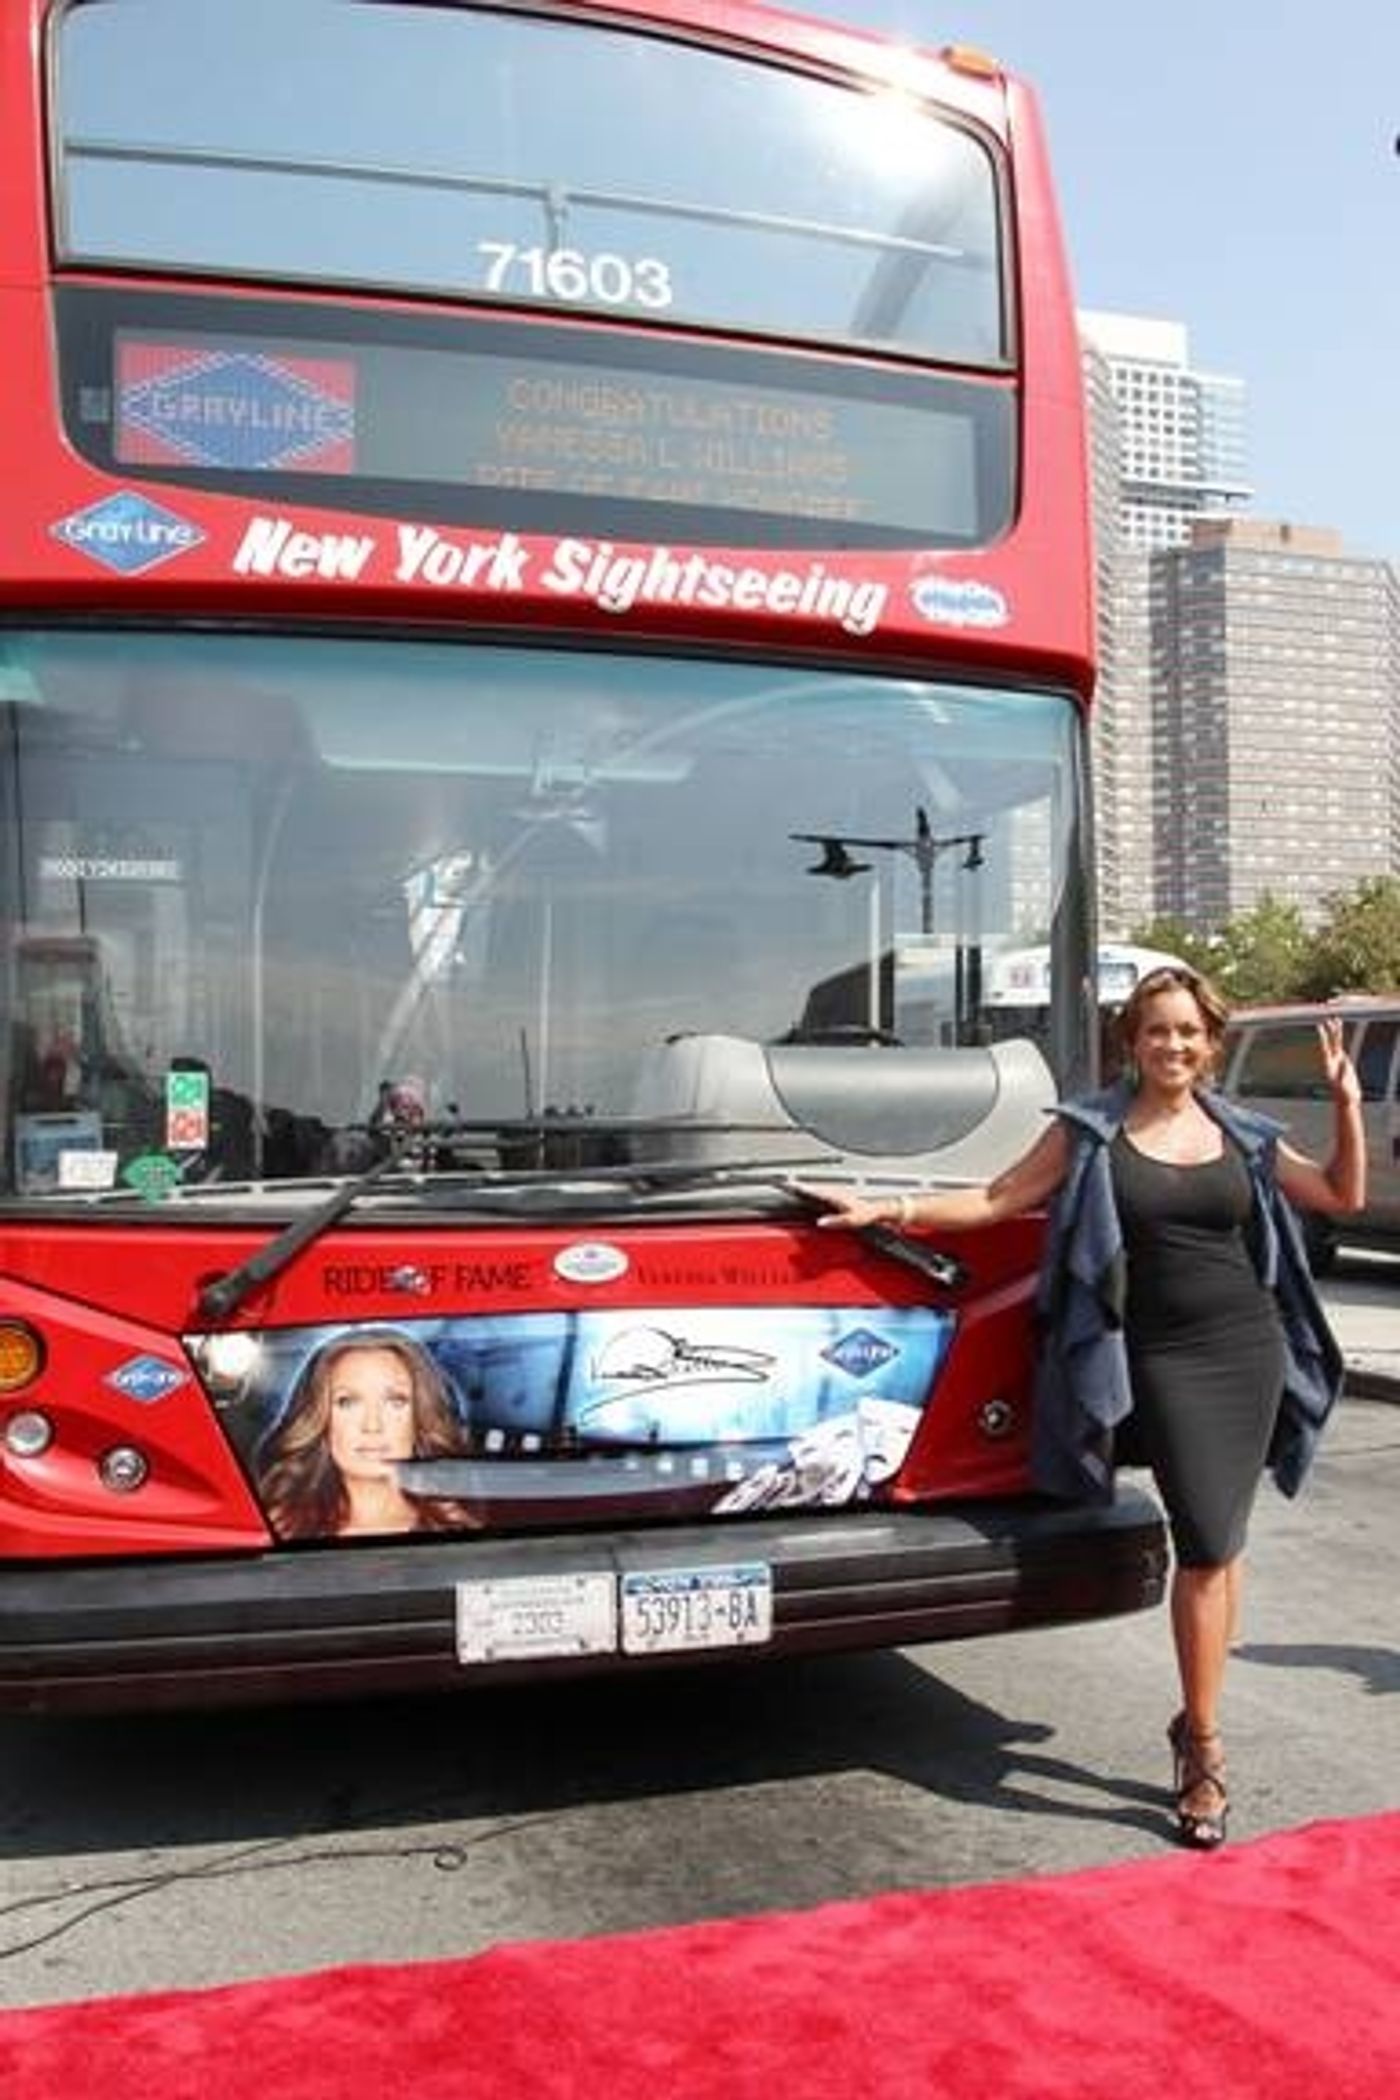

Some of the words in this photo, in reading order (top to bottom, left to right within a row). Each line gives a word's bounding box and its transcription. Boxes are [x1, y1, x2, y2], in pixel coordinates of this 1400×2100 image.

[477, 243, 672, 307] 71603
[152, 392, 336, 431] GRAYLINE
[233, 516, 372, 580] New
[396, 524, 532, 592] York
[541, 538, 888, 636] Sightseeing
[455, 1264, 532, 1292] FAME
